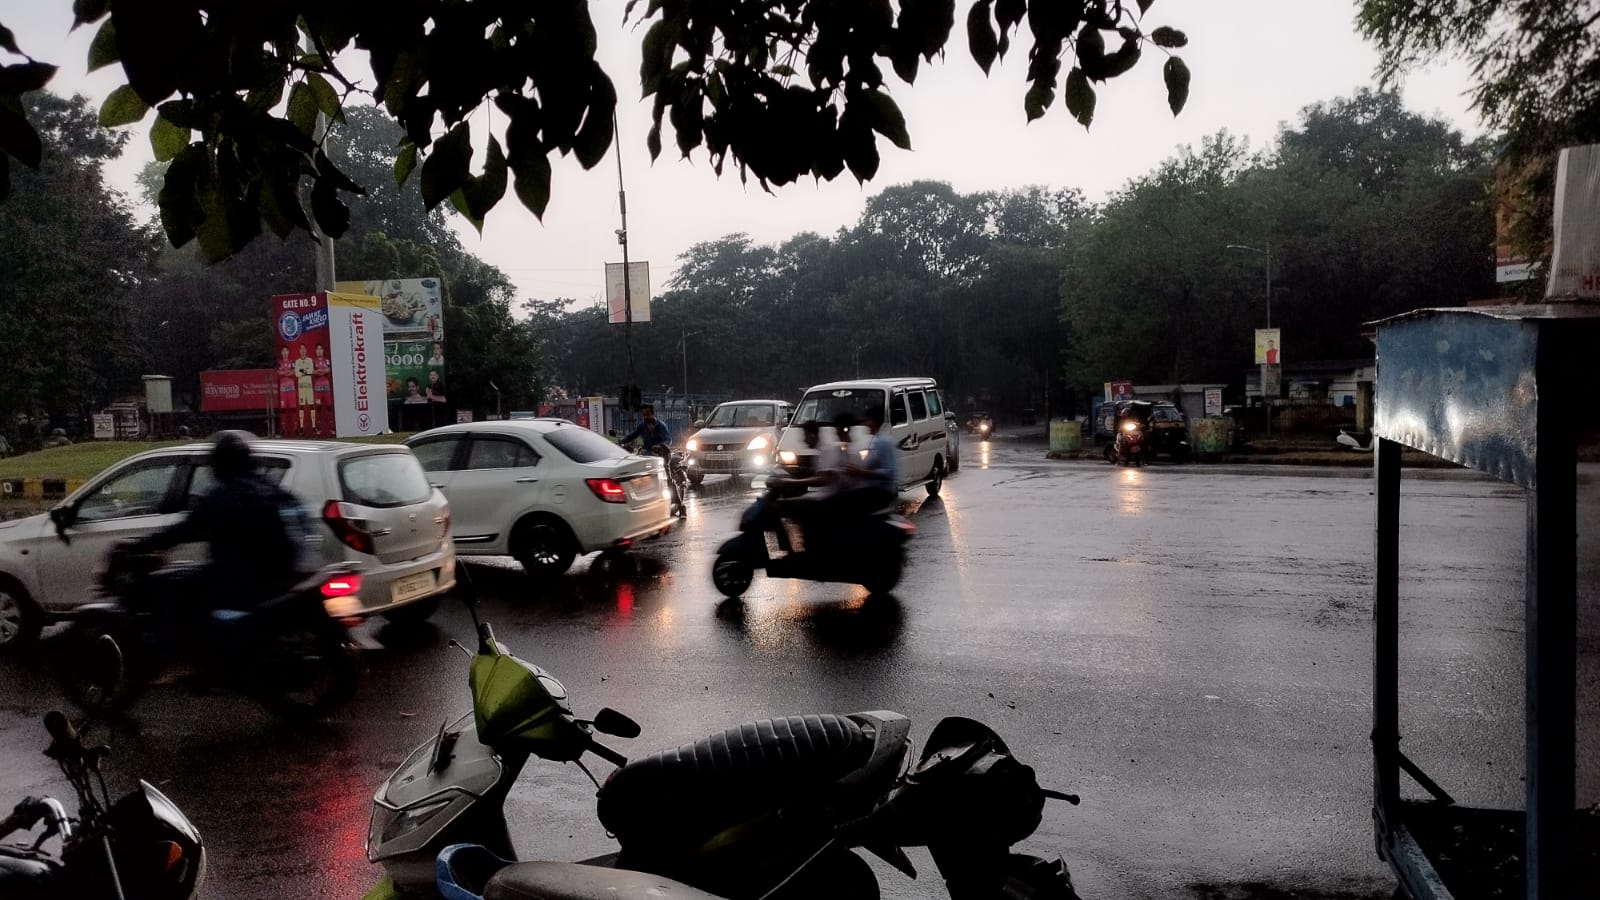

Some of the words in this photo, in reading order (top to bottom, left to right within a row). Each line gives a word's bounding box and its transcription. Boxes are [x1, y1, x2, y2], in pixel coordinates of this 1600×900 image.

[282, 299, 298, 309] GATE
[299, 298, 310, 307] NO.
[311, 295, 317, 307] 9
[352, 312, 369, 412] Elektrokraft
